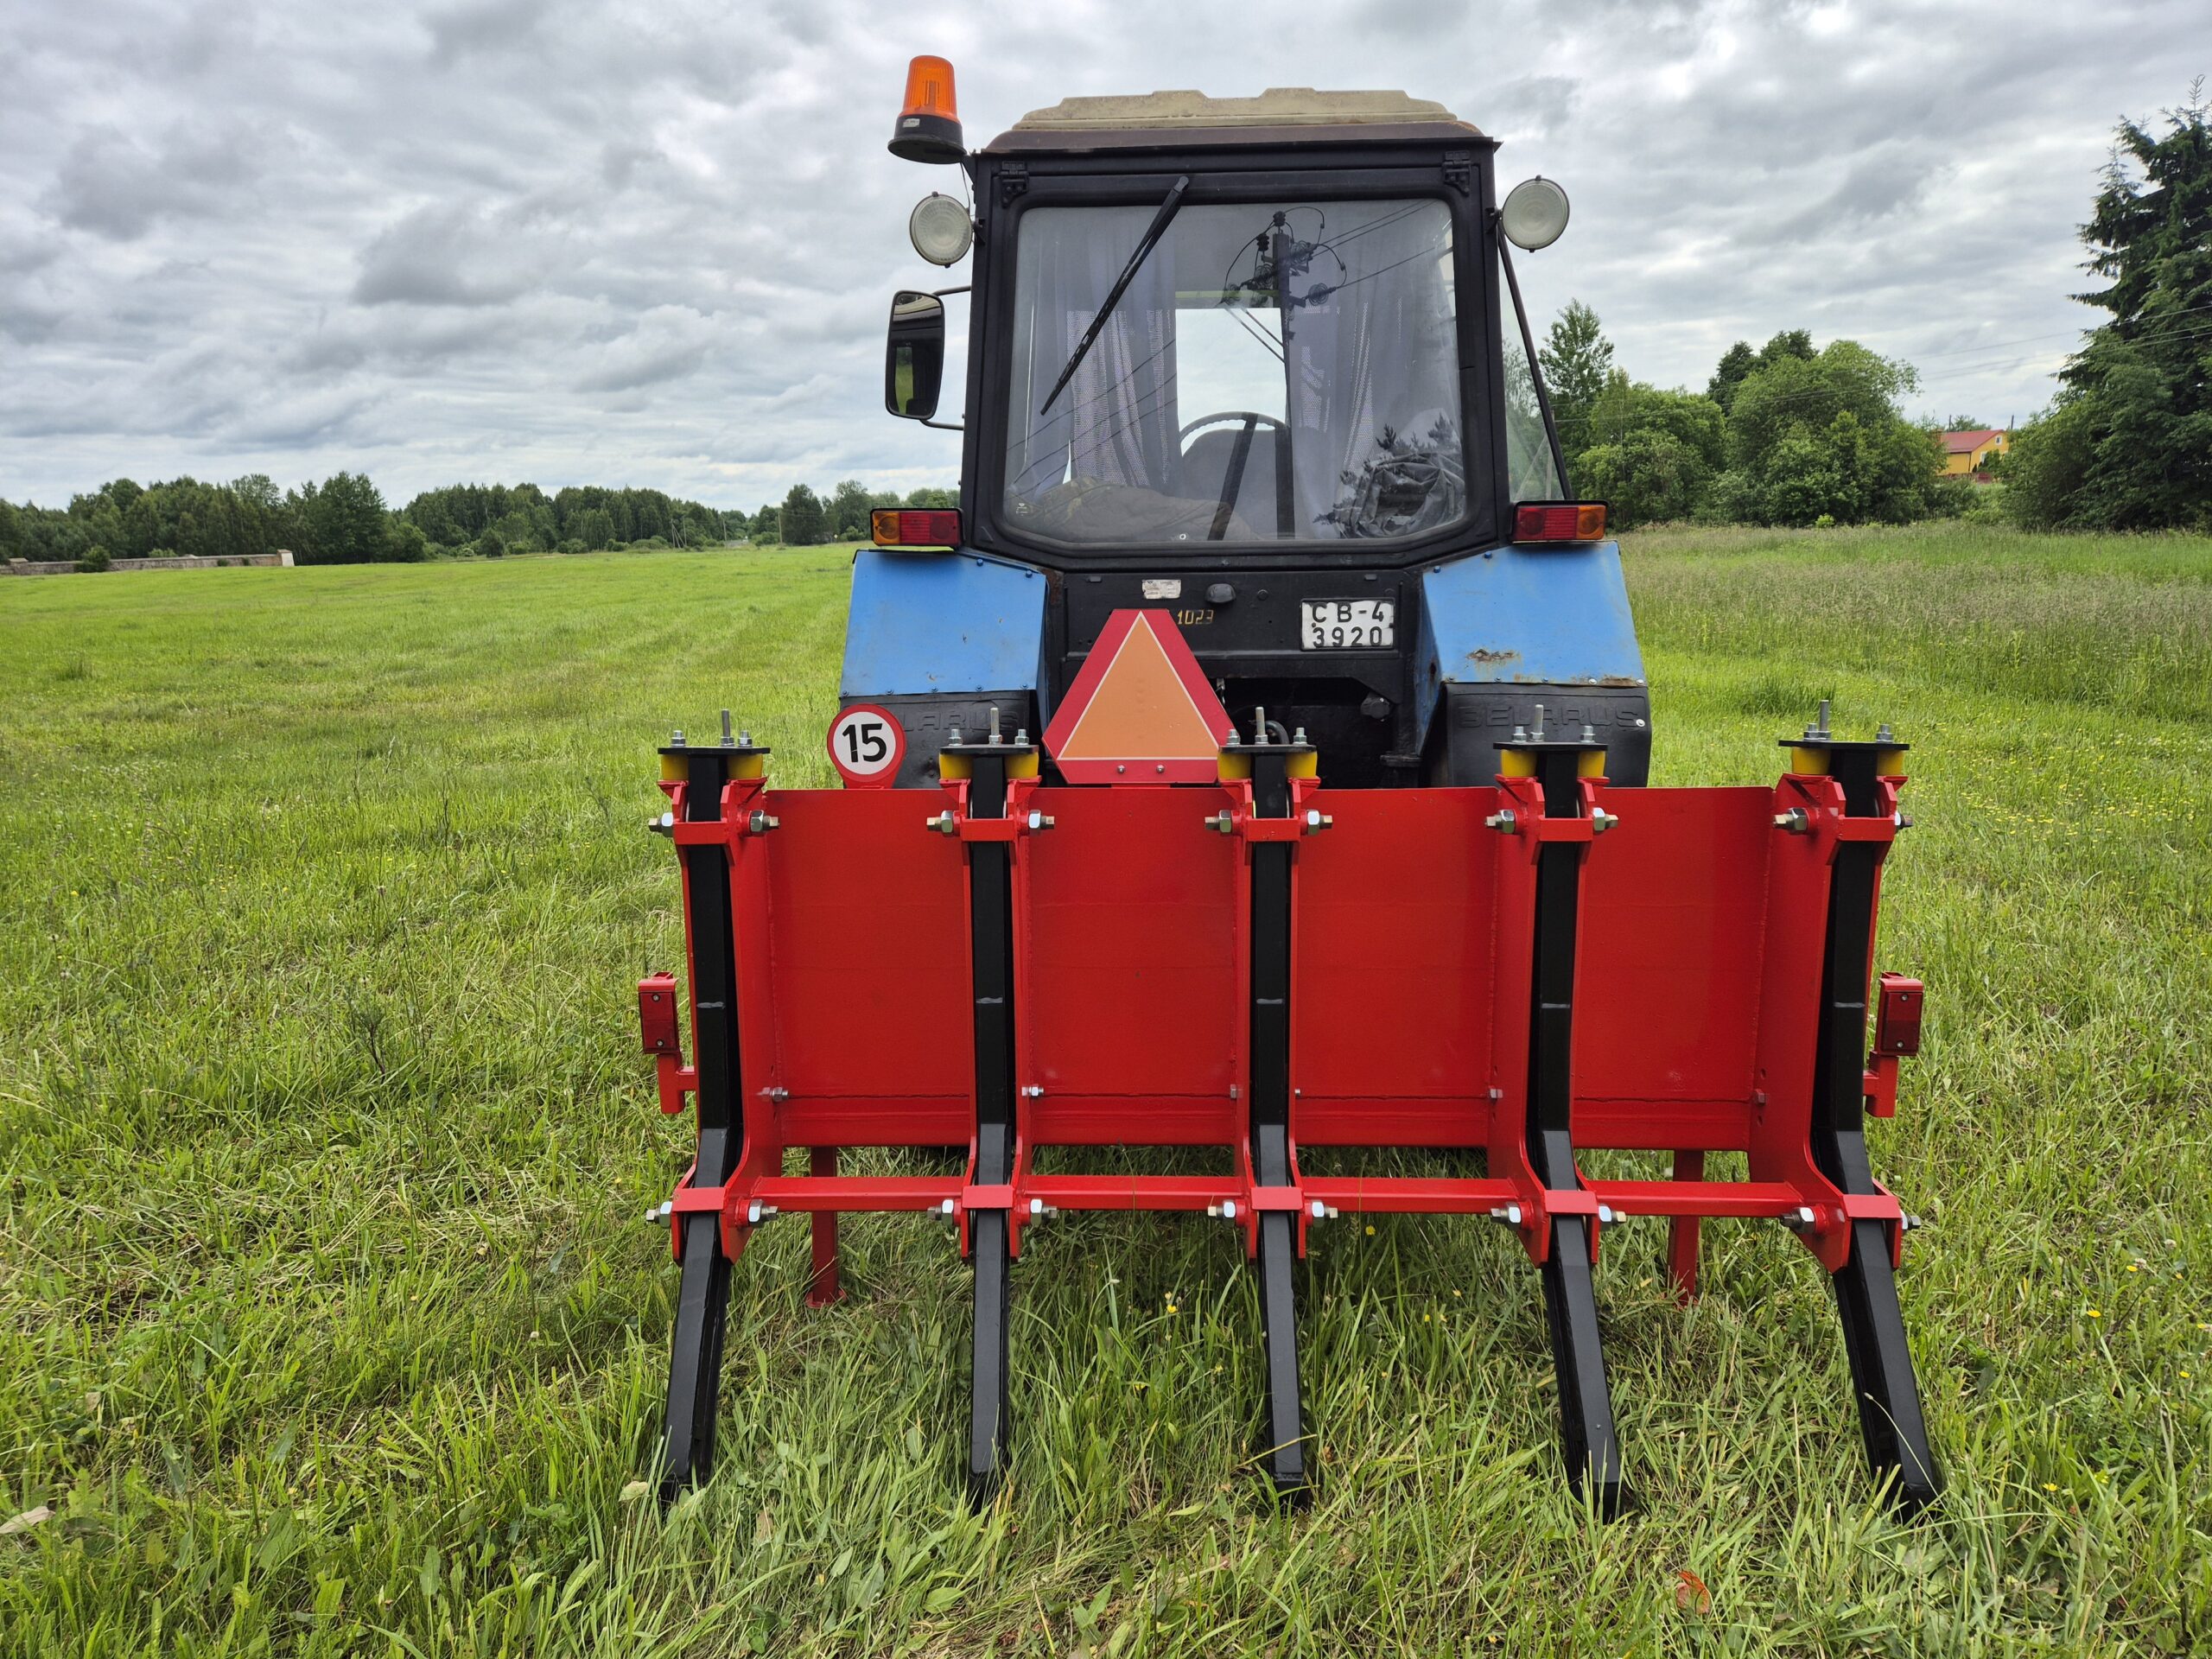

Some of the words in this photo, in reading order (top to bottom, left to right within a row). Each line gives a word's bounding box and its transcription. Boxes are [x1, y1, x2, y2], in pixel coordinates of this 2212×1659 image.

[1178, 609, 1215, 625] 1023
[1313, 626, 1382, 647] 3920
[901, 709, 1018, 732] LARUS
[842, 722, 887, 763] 15
